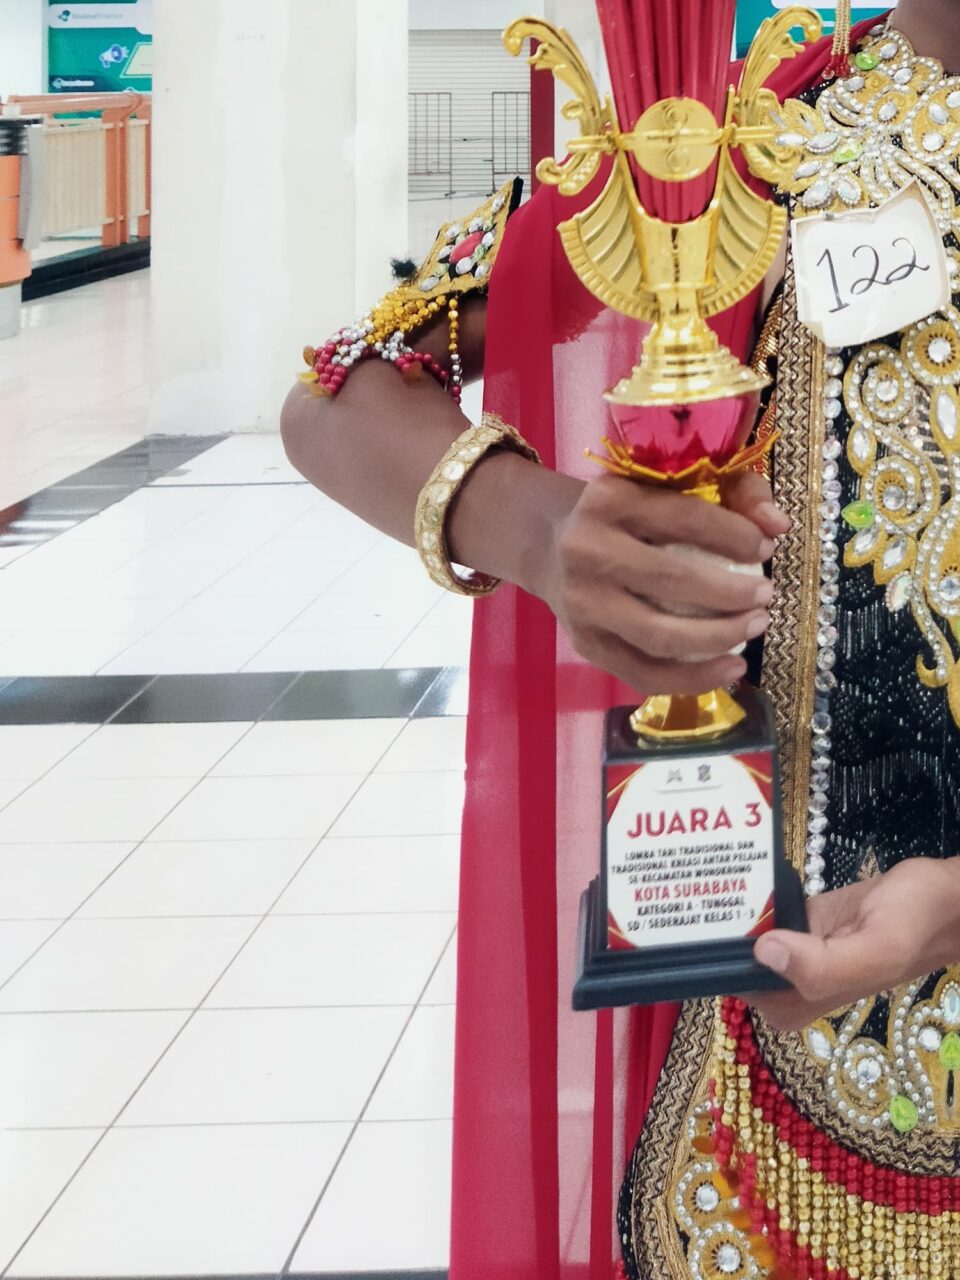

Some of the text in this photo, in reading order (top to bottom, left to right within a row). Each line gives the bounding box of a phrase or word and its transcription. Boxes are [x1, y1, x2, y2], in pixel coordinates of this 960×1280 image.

[816, 237, 930, 313] 122
[627, 803, 762, 839] JUARA 3
[612, 851, 768, 874] TRADISIONAL KREASI ANTAR PELAJAR
[625, 841, 754, 861] LOMBA TARI TRADISIONAL DAN
[635, 877, 747, 902] KOTA SURABAYA
[637, 902, 684, 916] KATEGORI
[687, 901, 693, 911] A
[702, 896, 745, 909] TUNGGAL
[627, 921, 640, 932] SD
[648, 914, 701, 929] SEDERAJAT
[704, 910, 733, 923] KELAS
